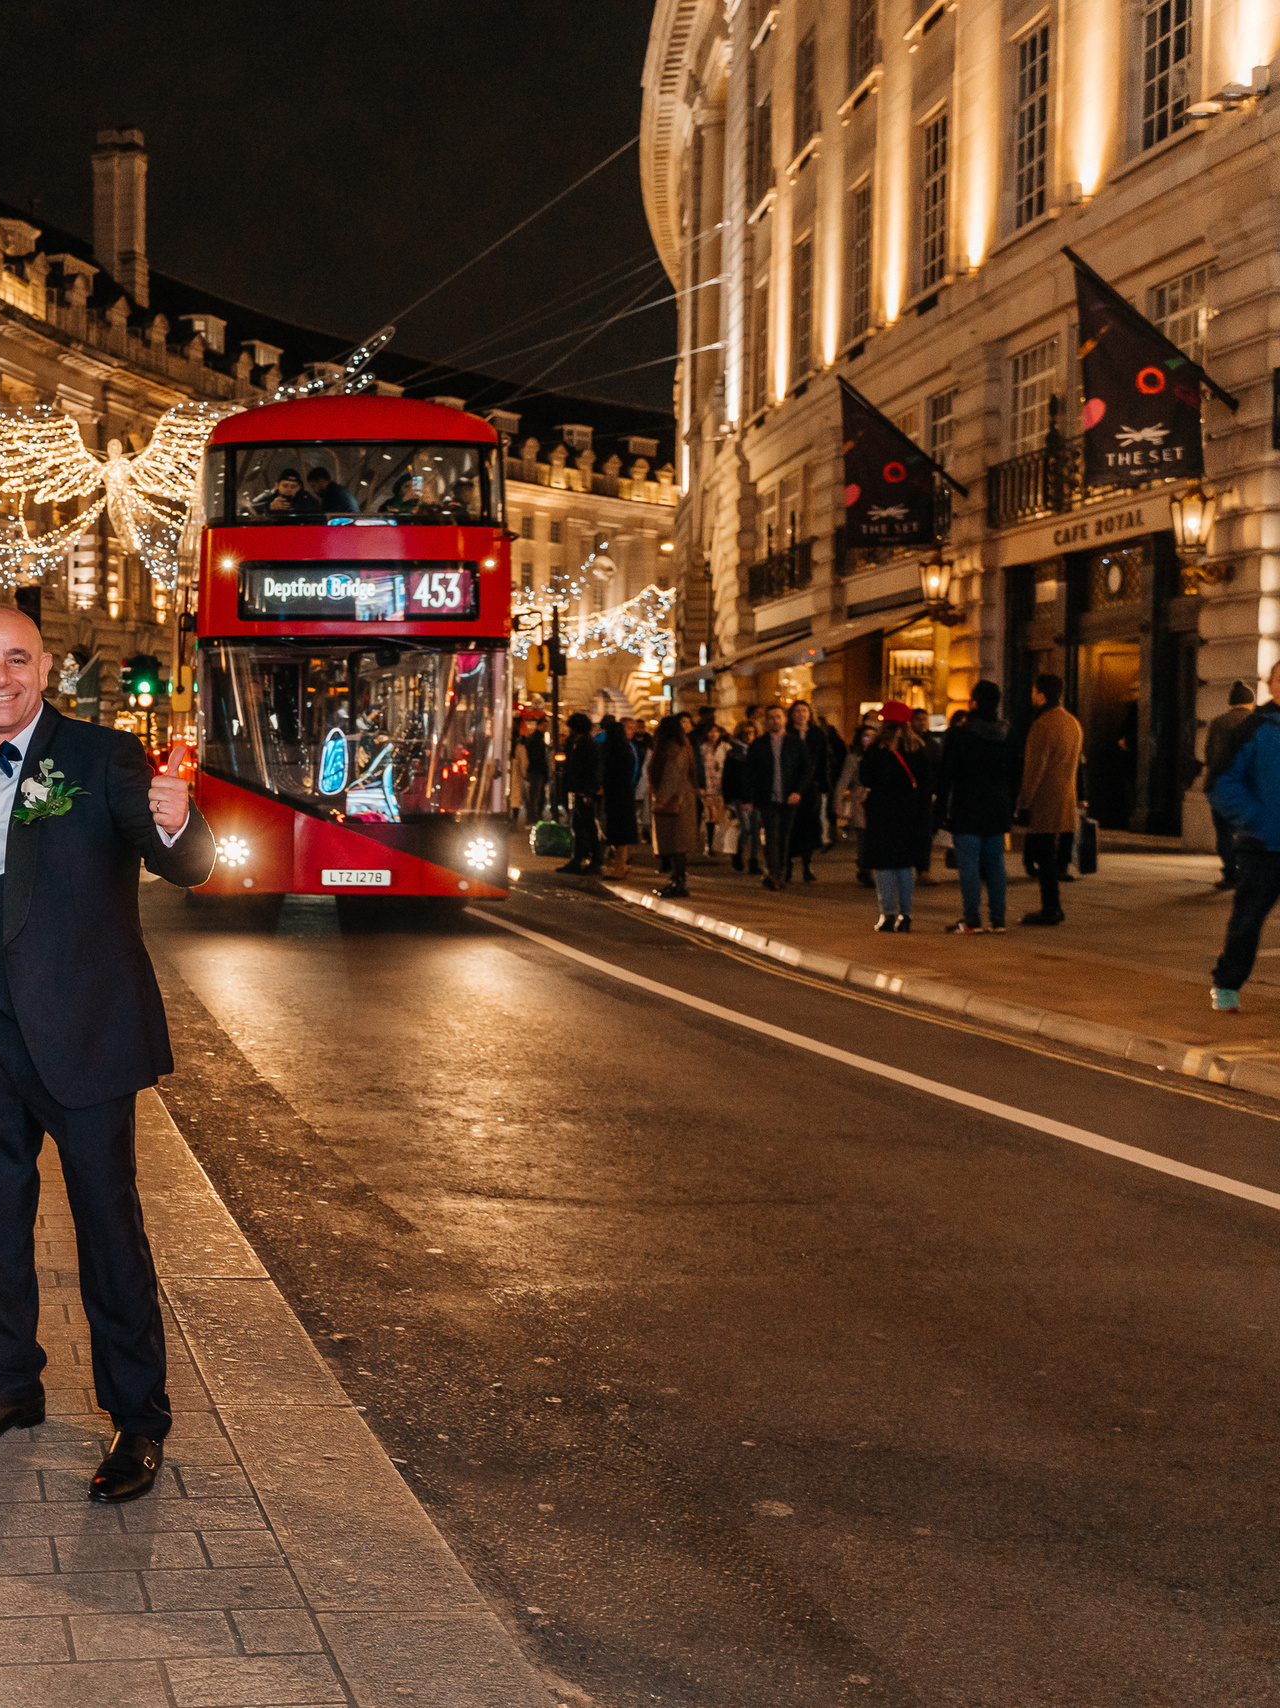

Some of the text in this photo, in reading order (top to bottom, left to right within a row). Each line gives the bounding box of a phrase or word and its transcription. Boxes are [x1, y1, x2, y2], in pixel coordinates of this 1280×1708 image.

[1105, 446, 1185, 467] THE SET
[264, 577, 376, 602] Deptford Bridge
[412, 572, 462, 608] 453
